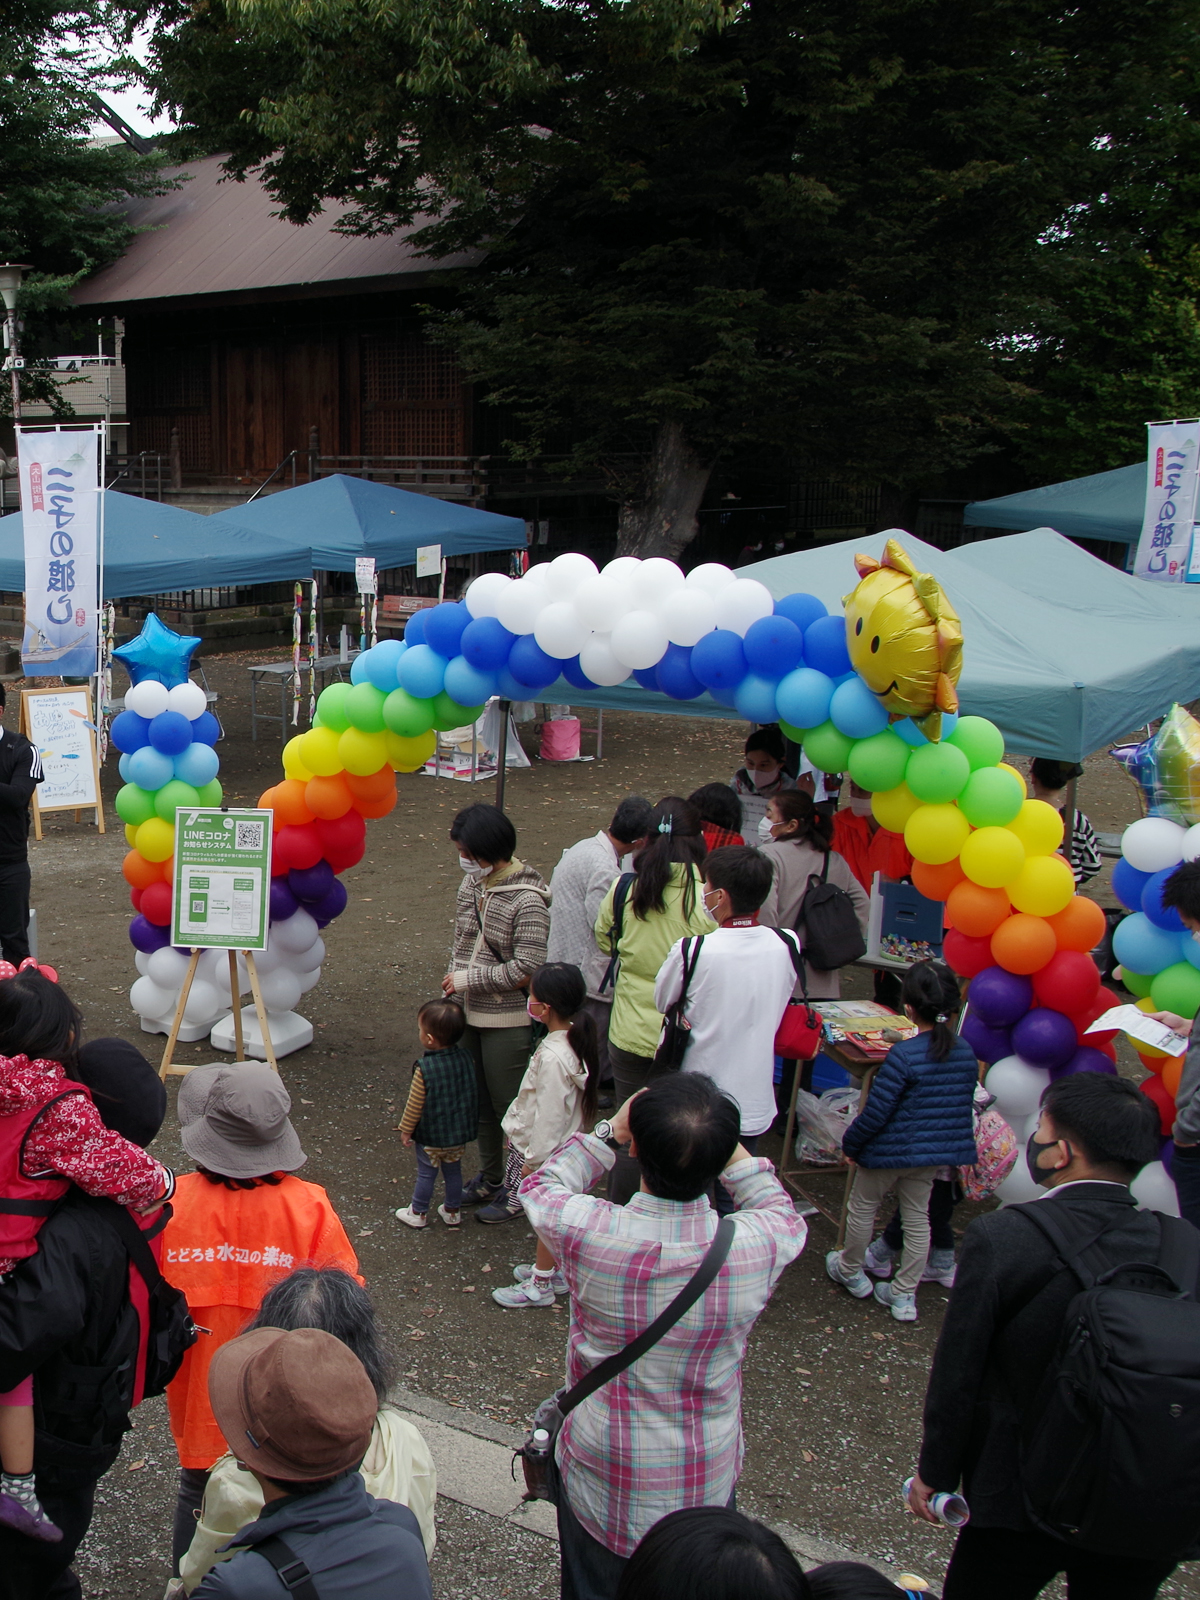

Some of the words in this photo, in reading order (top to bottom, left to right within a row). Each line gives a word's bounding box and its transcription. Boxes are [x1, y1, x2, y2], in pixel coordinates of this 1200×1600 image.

[184, 830, 231, 840] LINEコロナ
[183, 841, 232, 849] お知らせシステム
[166, 1242, 294, 1269] とどろき水辺の楽校
